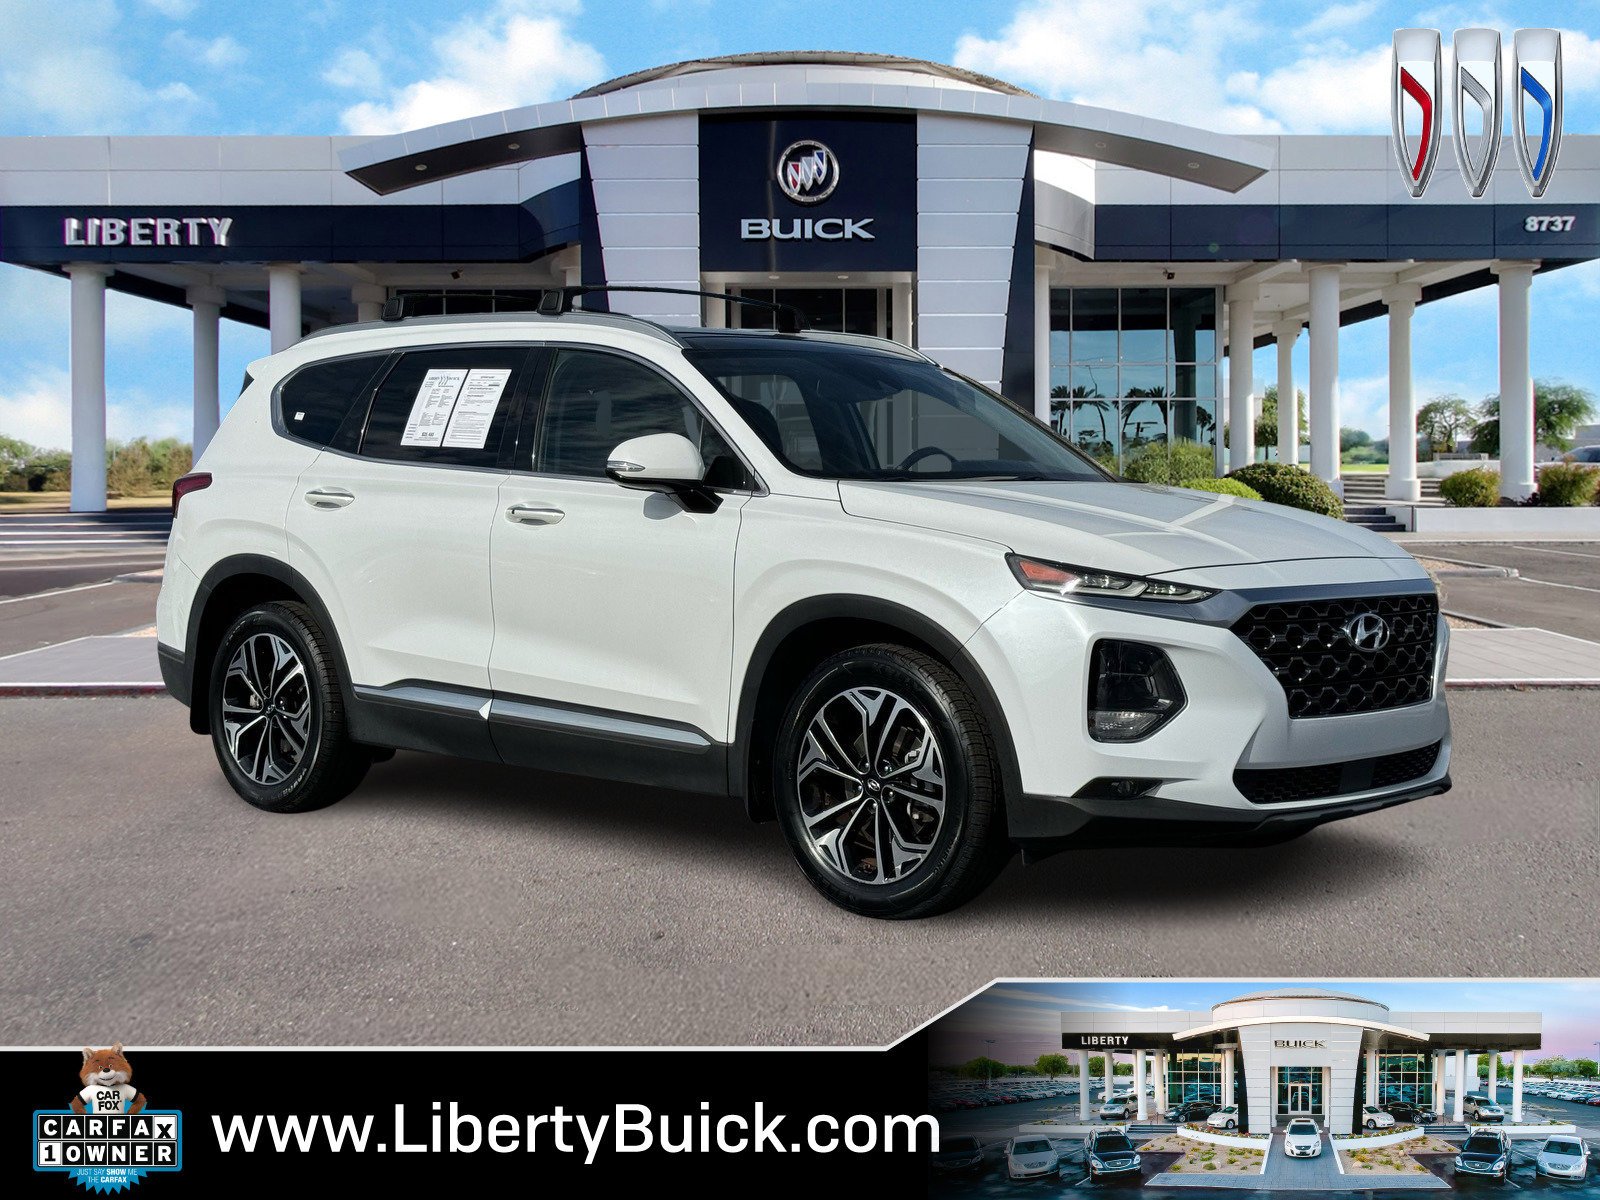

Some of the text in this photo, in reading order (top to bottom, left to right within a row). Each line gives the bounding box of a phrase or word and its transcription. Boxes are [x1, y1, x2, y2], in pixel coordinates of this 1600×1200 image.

[64, 217, 233, 247] LIBERTY
[740, 217, 876, 240] BUICK
[1524, 215, 1576, 232] 8737
